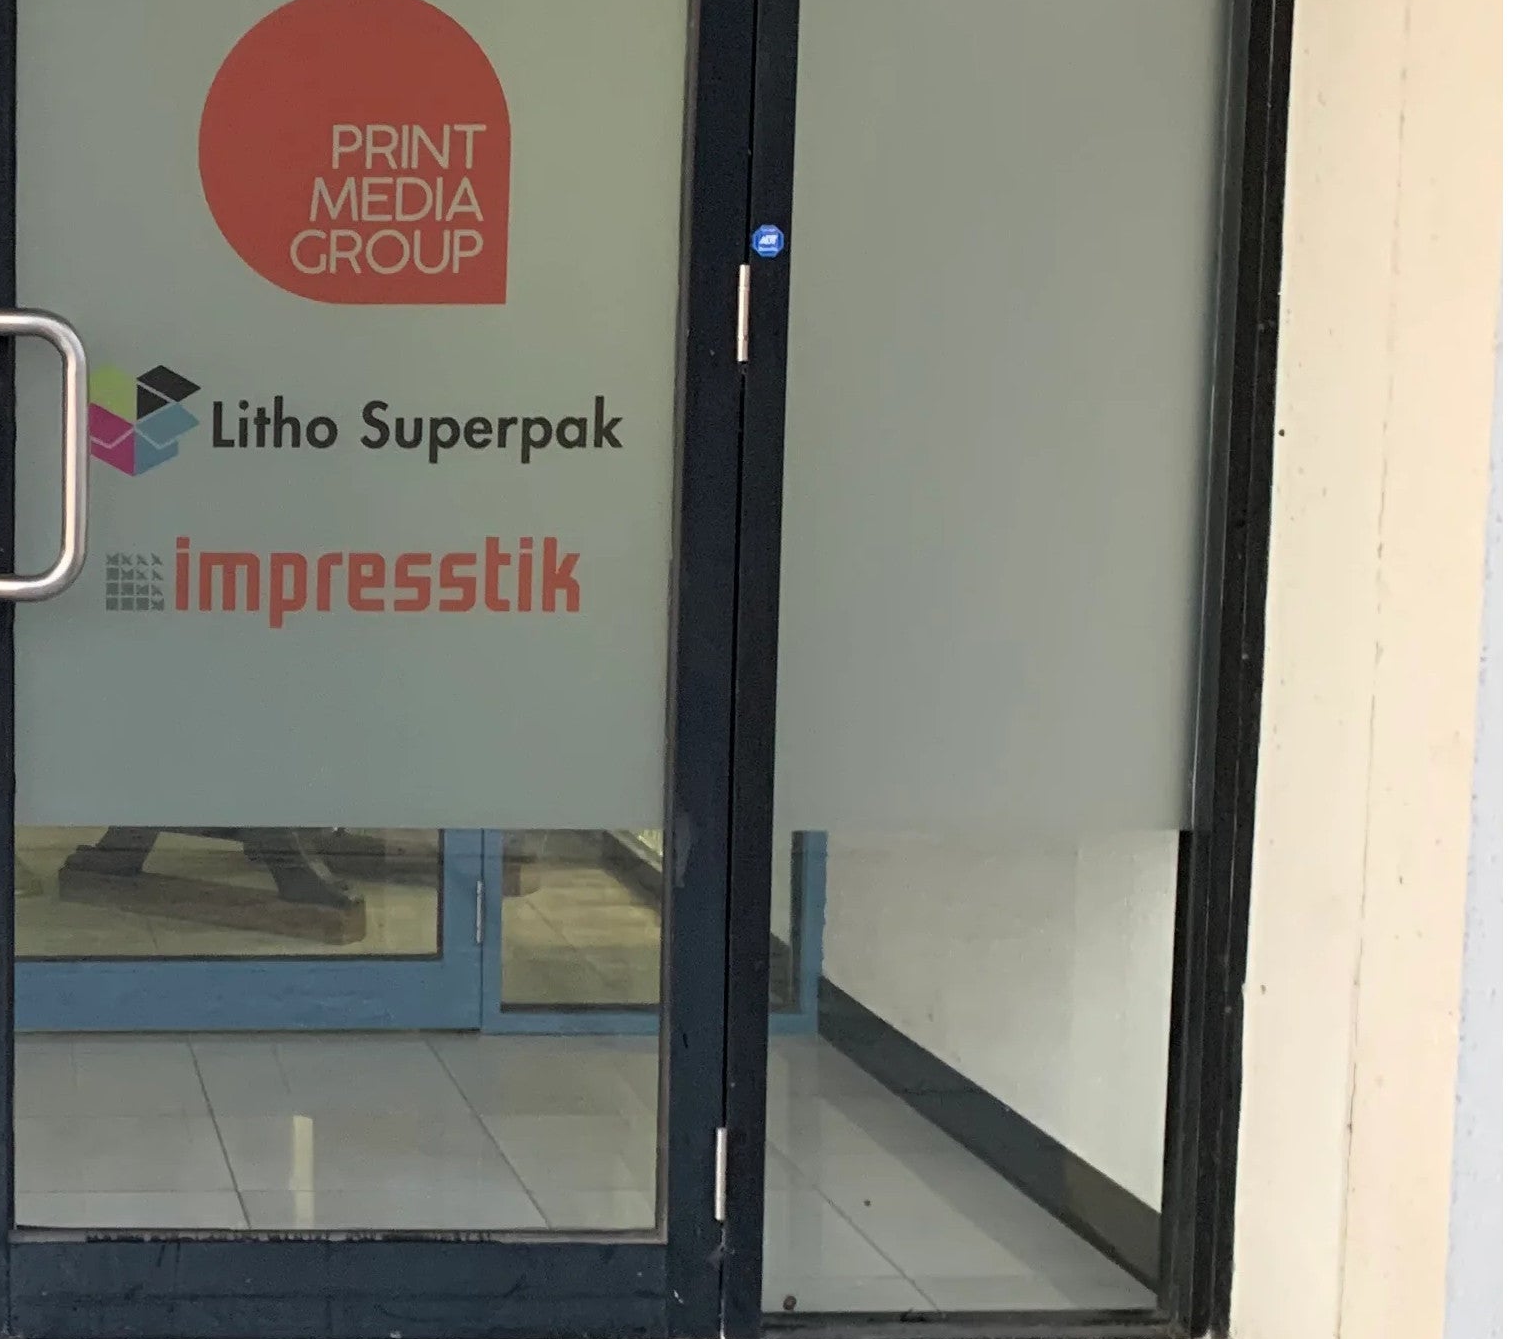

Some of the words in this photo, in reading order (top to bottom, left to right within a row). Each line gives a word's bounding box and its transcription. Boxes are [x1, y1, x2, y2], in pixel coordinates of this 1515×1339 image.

[331, 123, 487, 170] PRINT
[309, 177, 484, 223] MEDIA
[289, 229, 484, 275] GROUP
[212, 395, 339, 451] Litho
[360, 395, 624, 465] Superpak
[175, 536, 582, 629] impresstik
